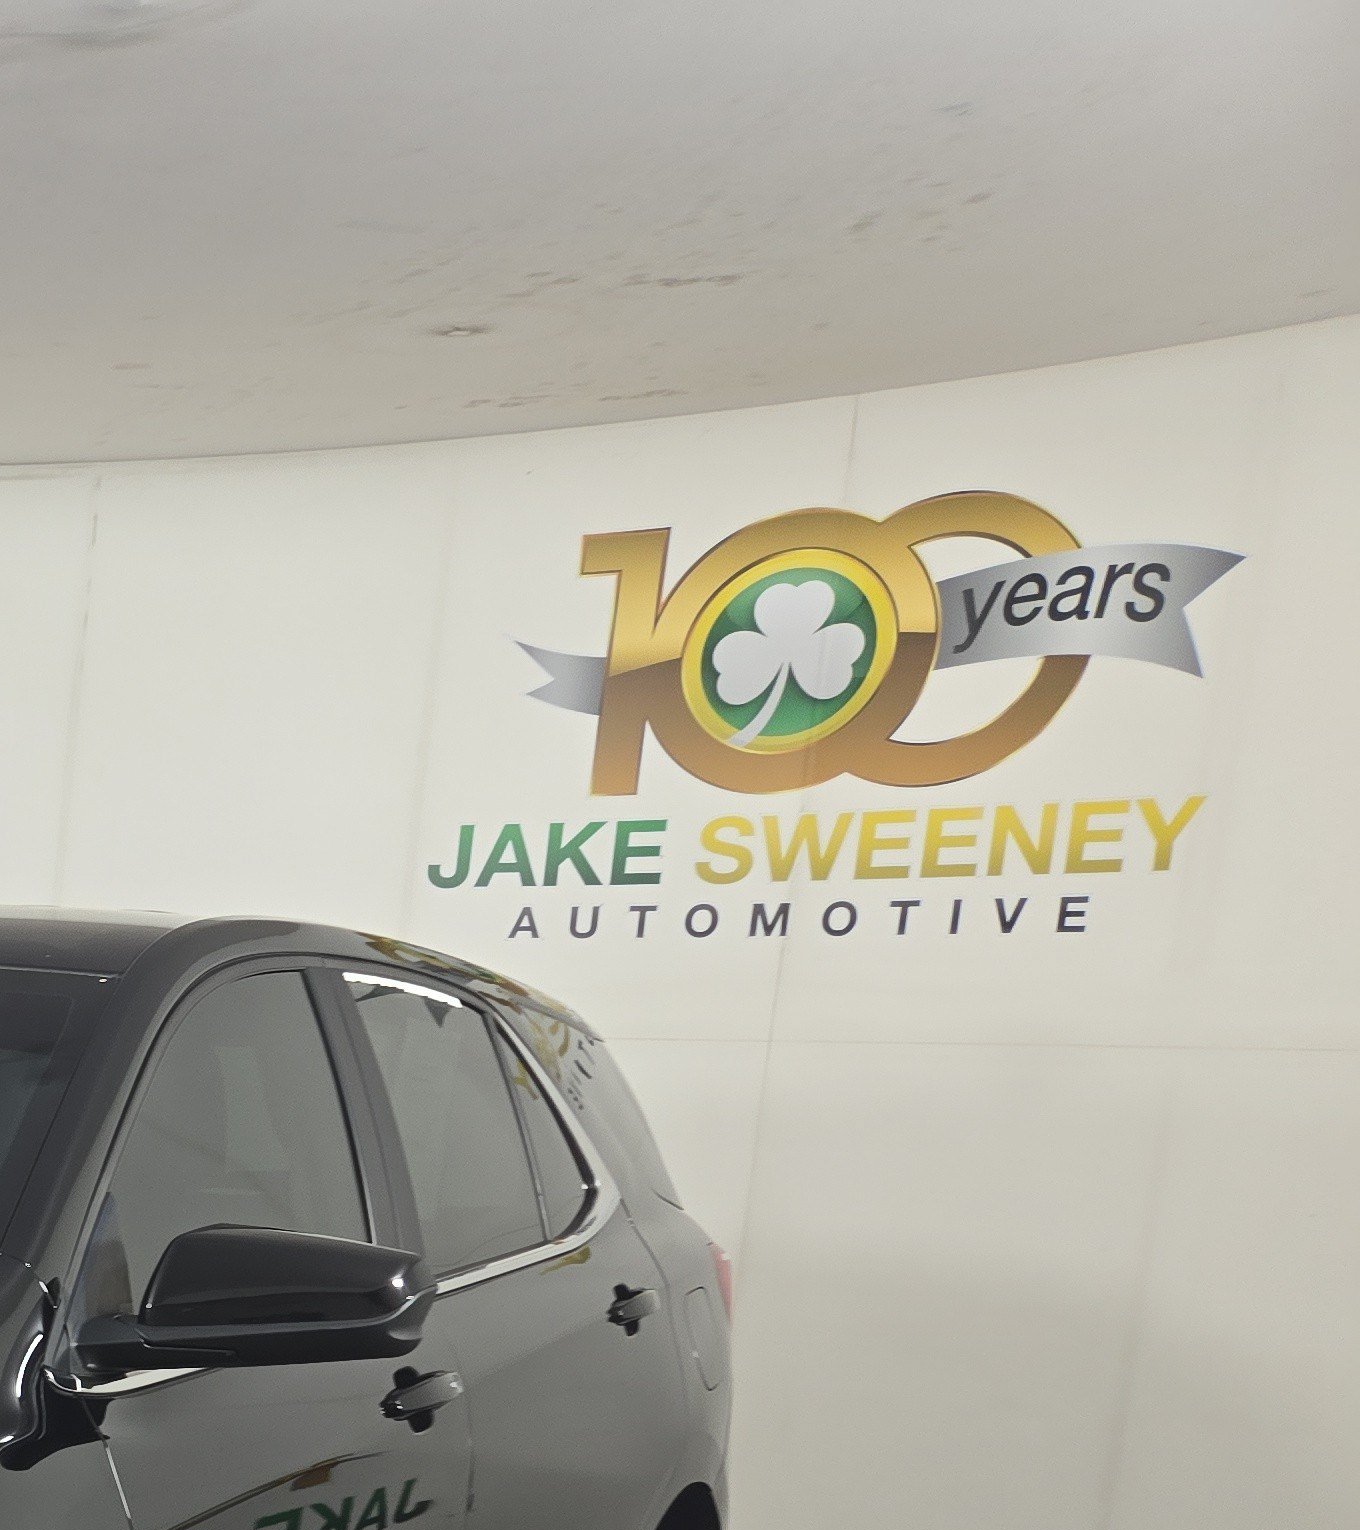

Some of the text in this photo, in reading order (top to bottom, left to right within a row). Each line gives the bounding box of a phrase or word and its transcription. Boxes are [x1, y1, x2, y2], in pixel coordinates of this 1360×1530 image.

[579, 489, 1171, 796] 100 years
[427, 794, 1208, 889] JAKE SWEENEY
[507, 894, 1090, 940] AUTOMOTIVE
